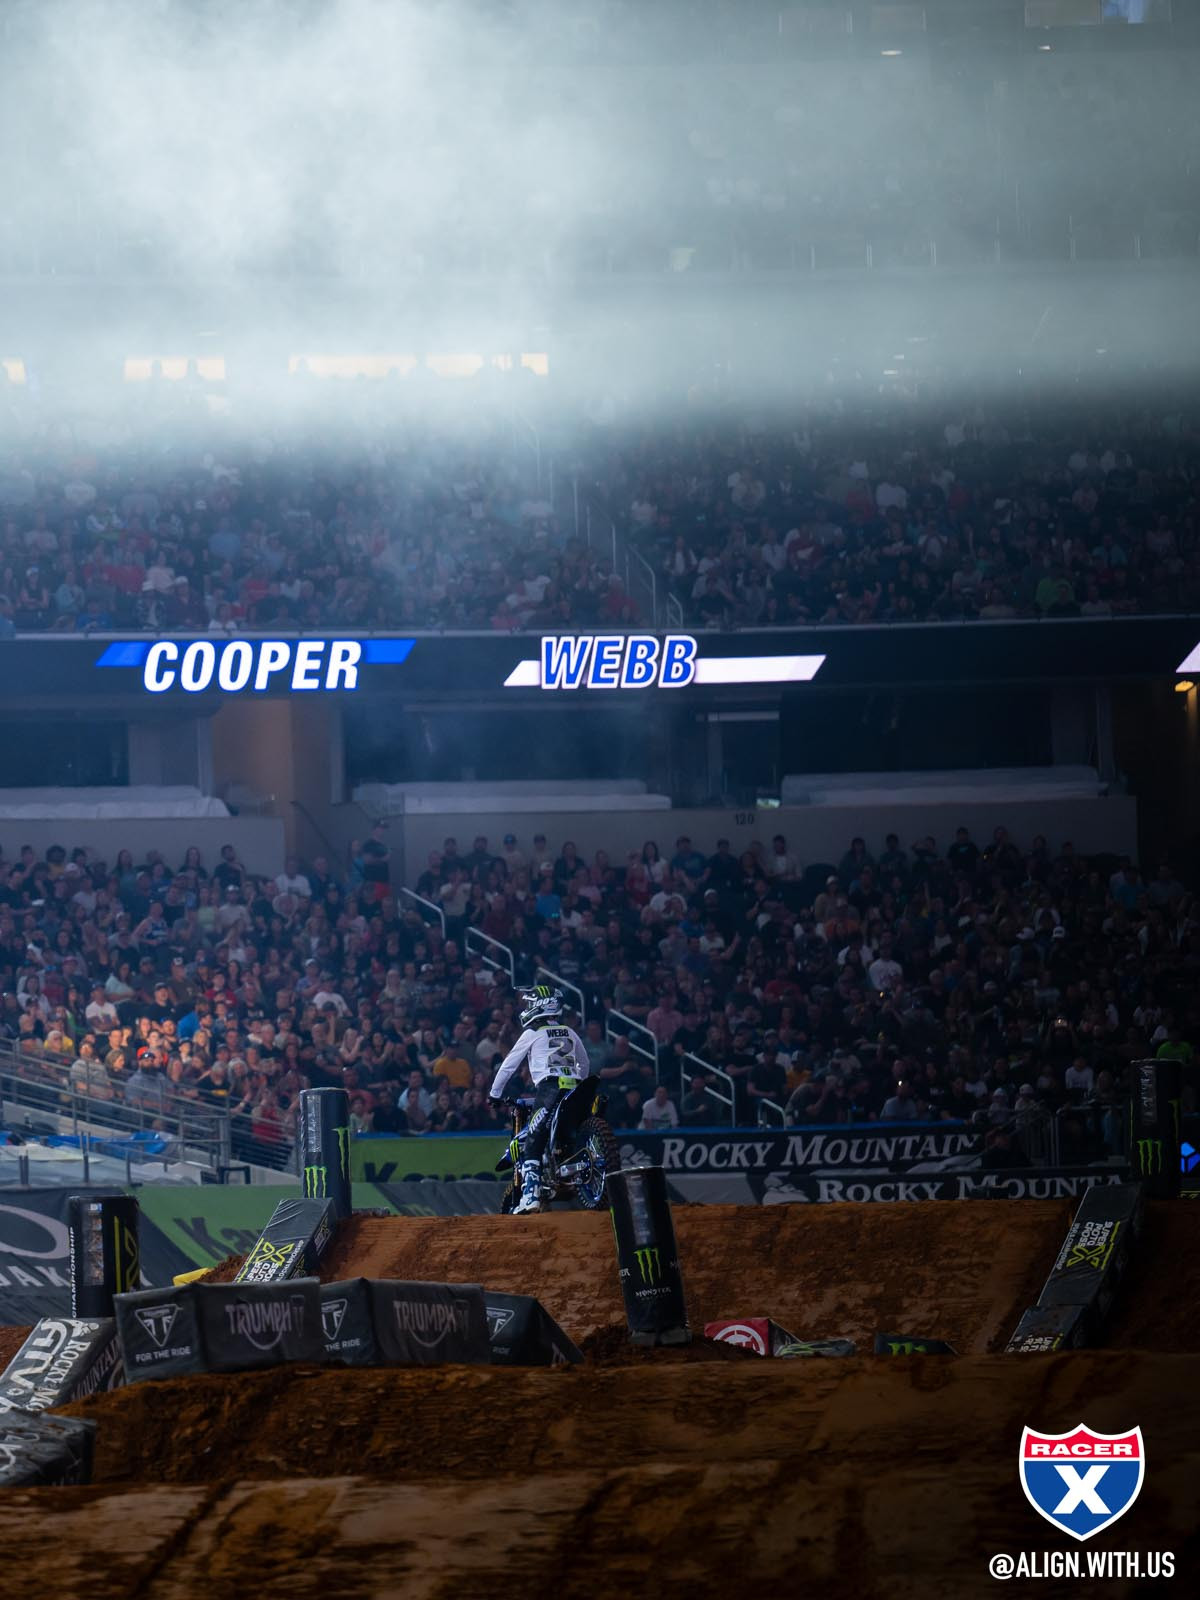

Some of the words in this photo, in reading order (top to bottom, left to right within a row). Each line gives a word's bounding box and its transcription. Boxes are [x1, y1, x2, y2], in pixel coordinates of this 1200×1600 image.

[143, 640, 362, 692] COOPER
[539, 635, 698, 689] WEBB
[735, 812, 755, 825] 120
[548, 1039, 575, 1067] 2
[529, 1107, 549, 1134] THOR
[661, 1138, 774, 1169] ROCKY
[780, 1134, 981, 1166] MOUNTAIN
[816, 1179, 944, 1203] ROCKY
[1087, 1223, 1104, 1246] MOTO
[69, 1226, 78, 1319] CHAMPIONSHIP
[225, 1302, 292, 1335] TRIUMPH
[393, 1300, 456, 1333] TRIUMPH
[135, 1352, 153, 1363] FOR
[154, 1349, 170, 1360] THE
[171, 1346, 191, 1357] RIDE
[324, 1340, 341, 1352] THE
[341, 1337, 361, 1349] RIDE
[43, 1339, 92, 1384] ROCKY
